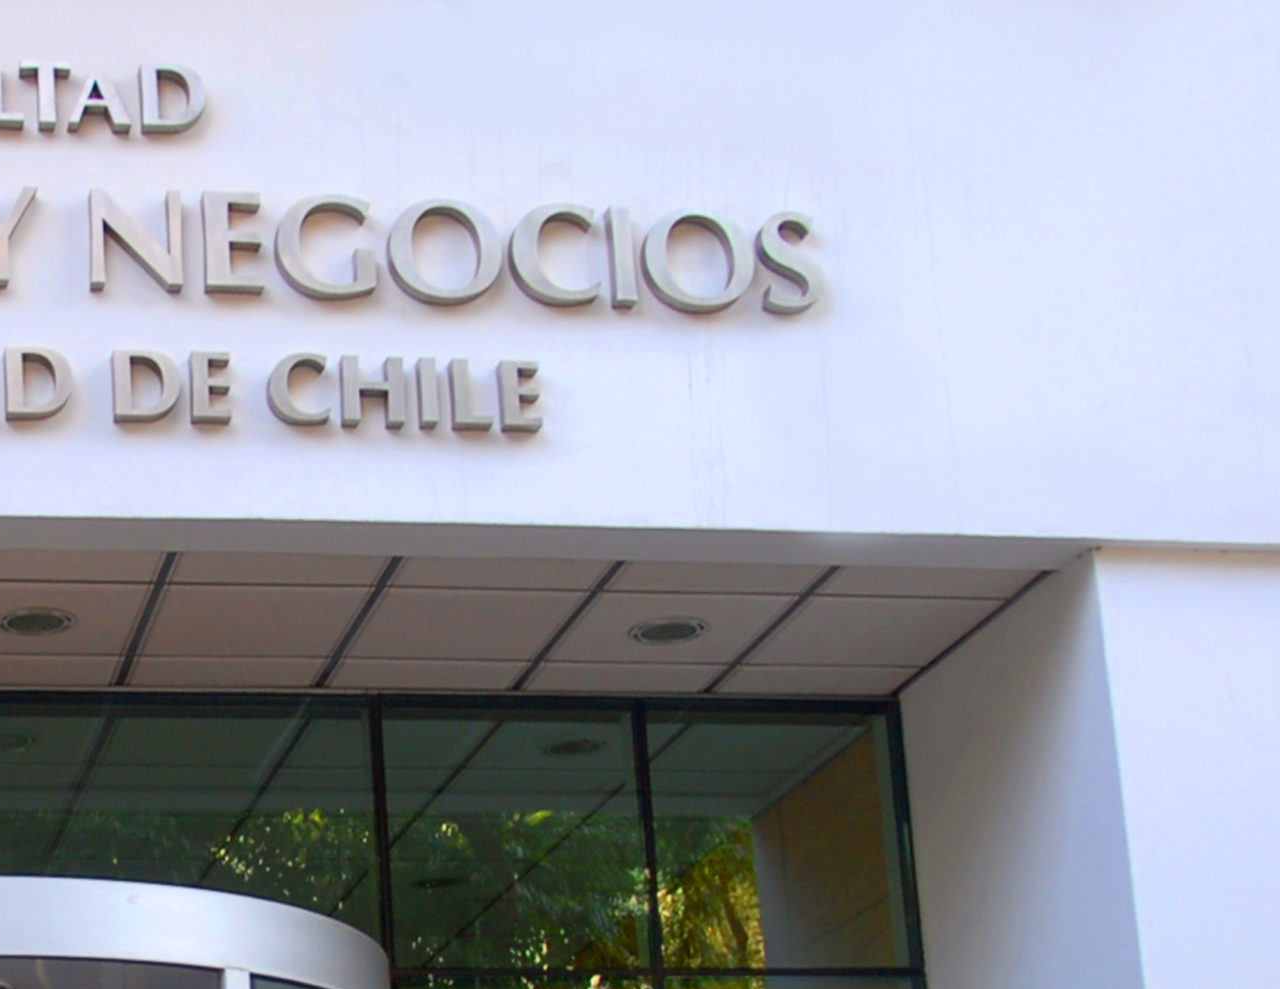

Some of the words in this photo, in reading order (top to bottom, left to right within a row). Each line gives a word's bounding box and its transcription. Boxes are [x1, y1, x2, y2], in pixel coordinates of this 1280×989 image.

[88, 187, 827, 315] NEGOCIOS
[111, 348, 233, 425] DE
[266, 352, 544, 434] CHILE
